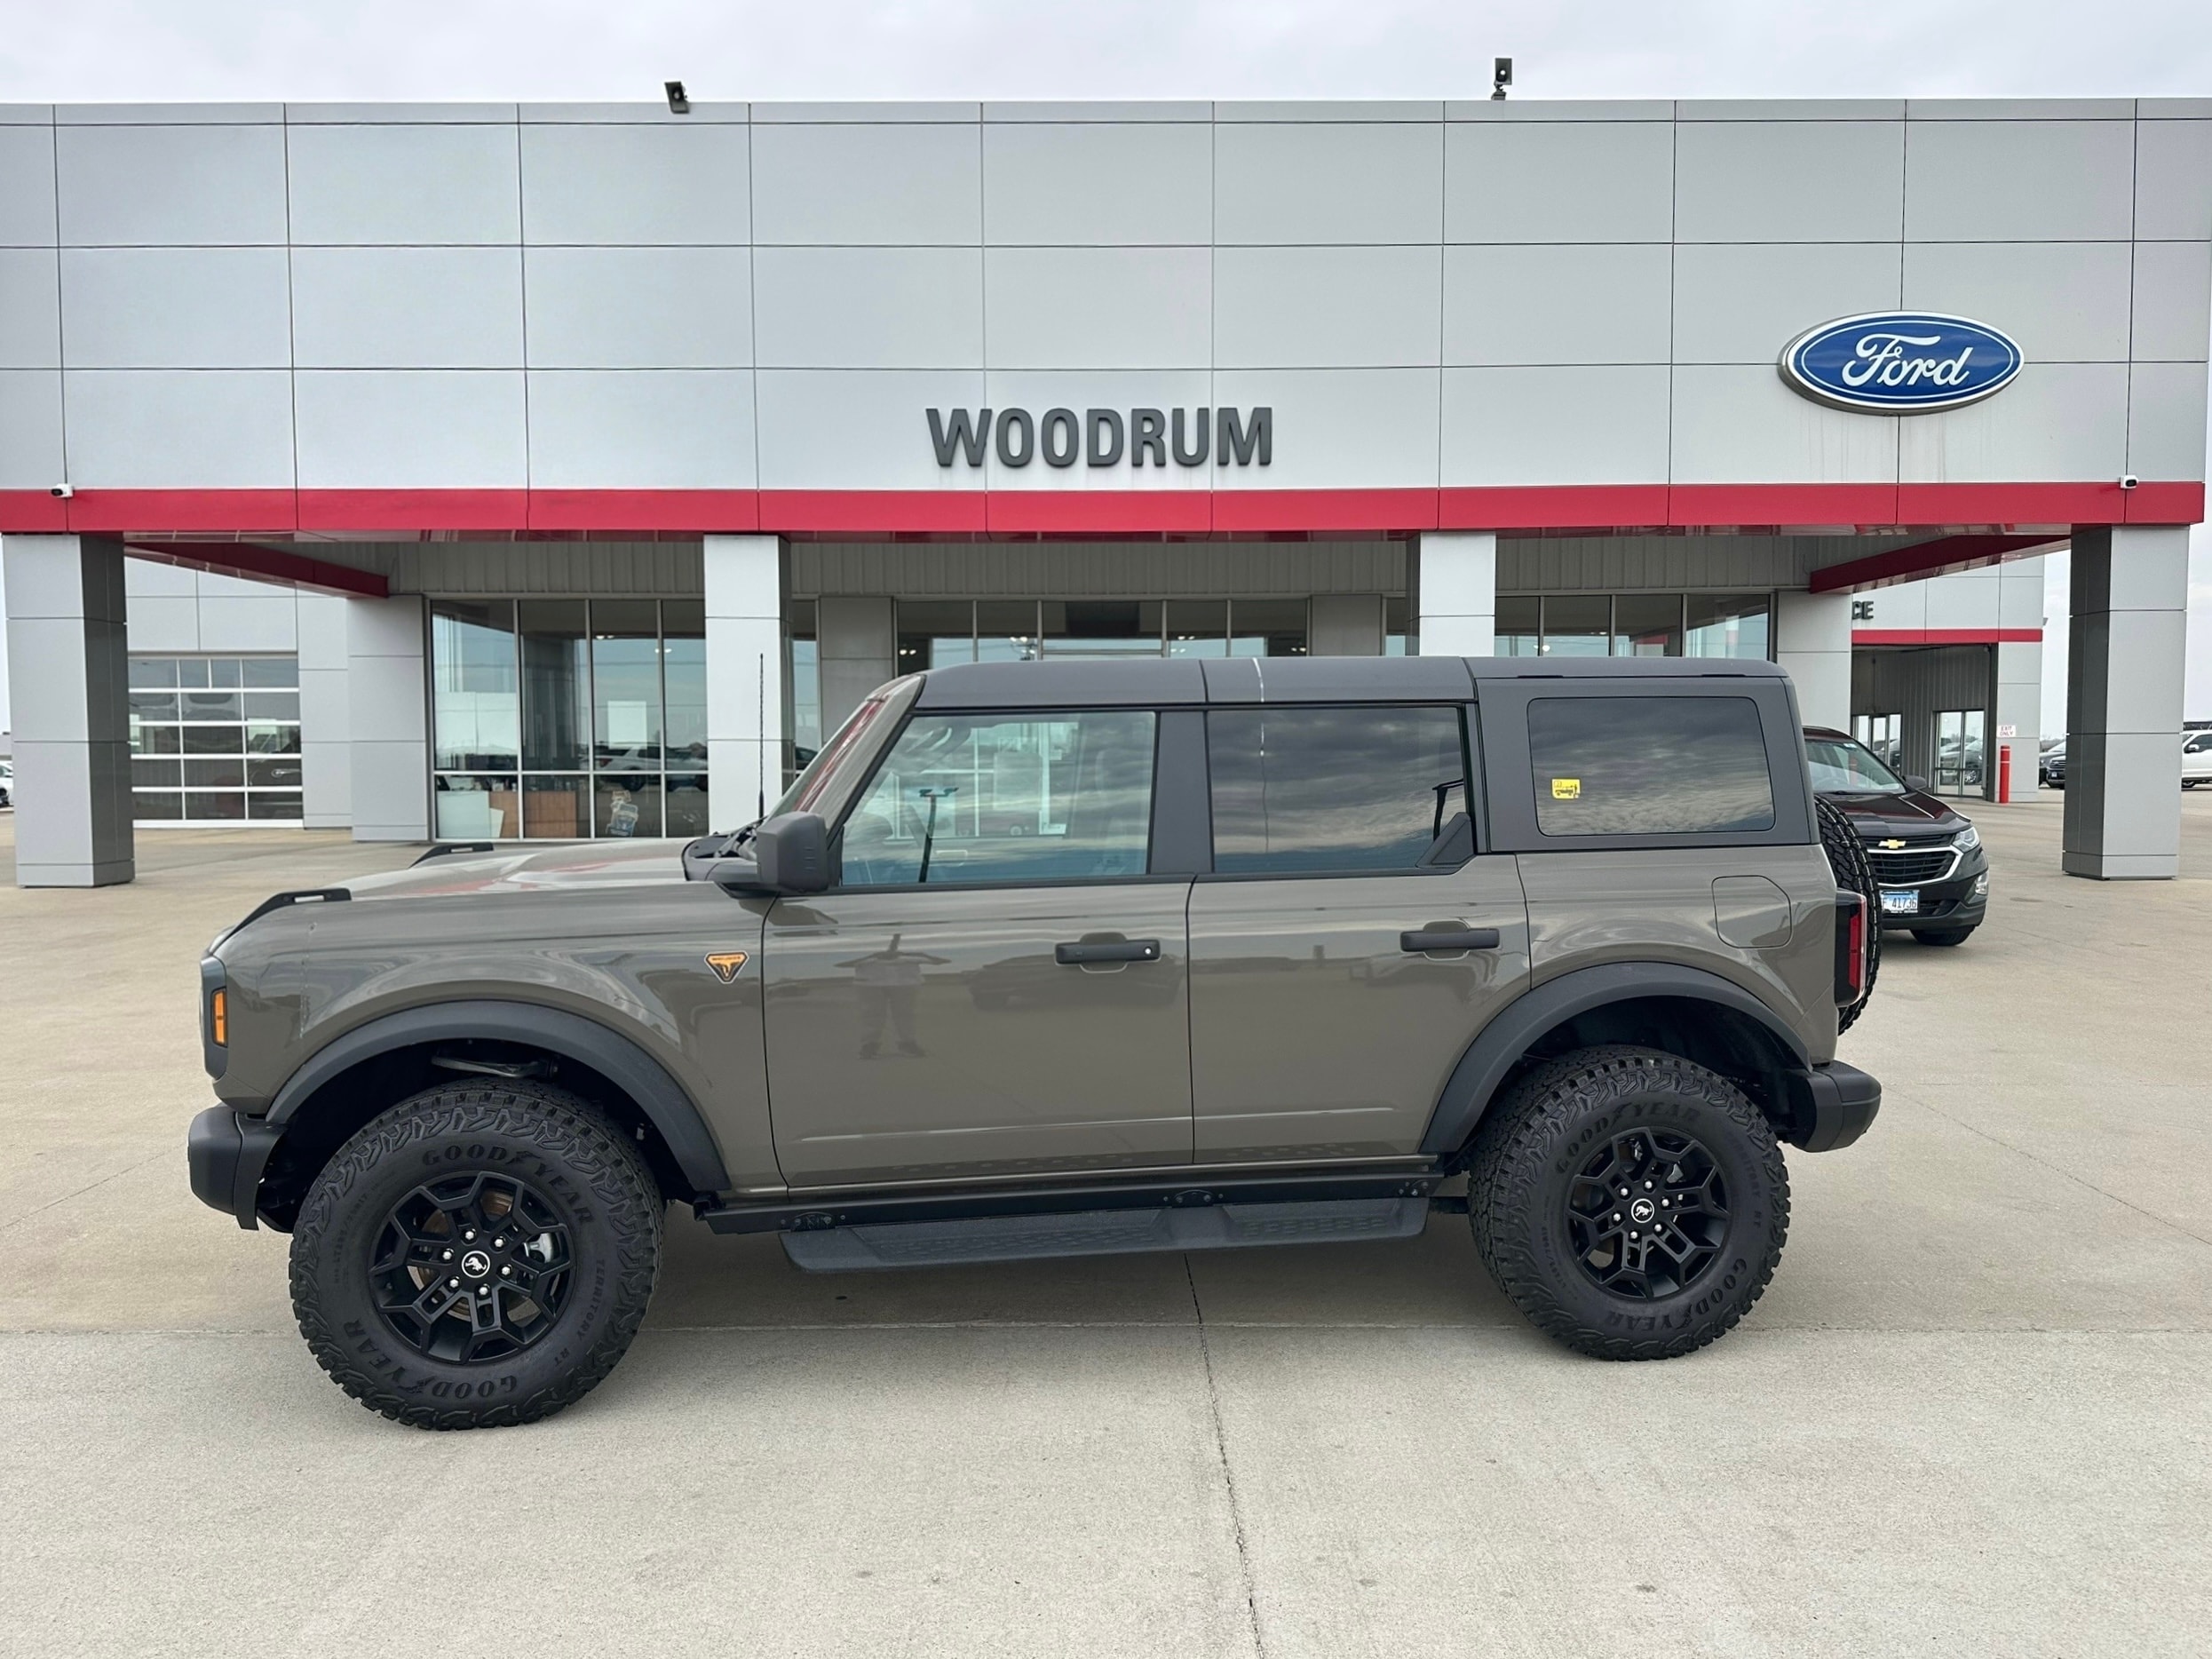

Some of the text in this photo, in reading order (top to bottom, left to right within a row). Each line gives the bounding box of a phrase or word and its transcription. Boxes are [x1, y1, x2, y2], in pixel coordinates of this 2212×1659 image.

[1842, 333, 1973, 386] Ford
[925, 407, 1272, 468] WOODRUM
[576, 1259, 606, 1341] TERRITORY
